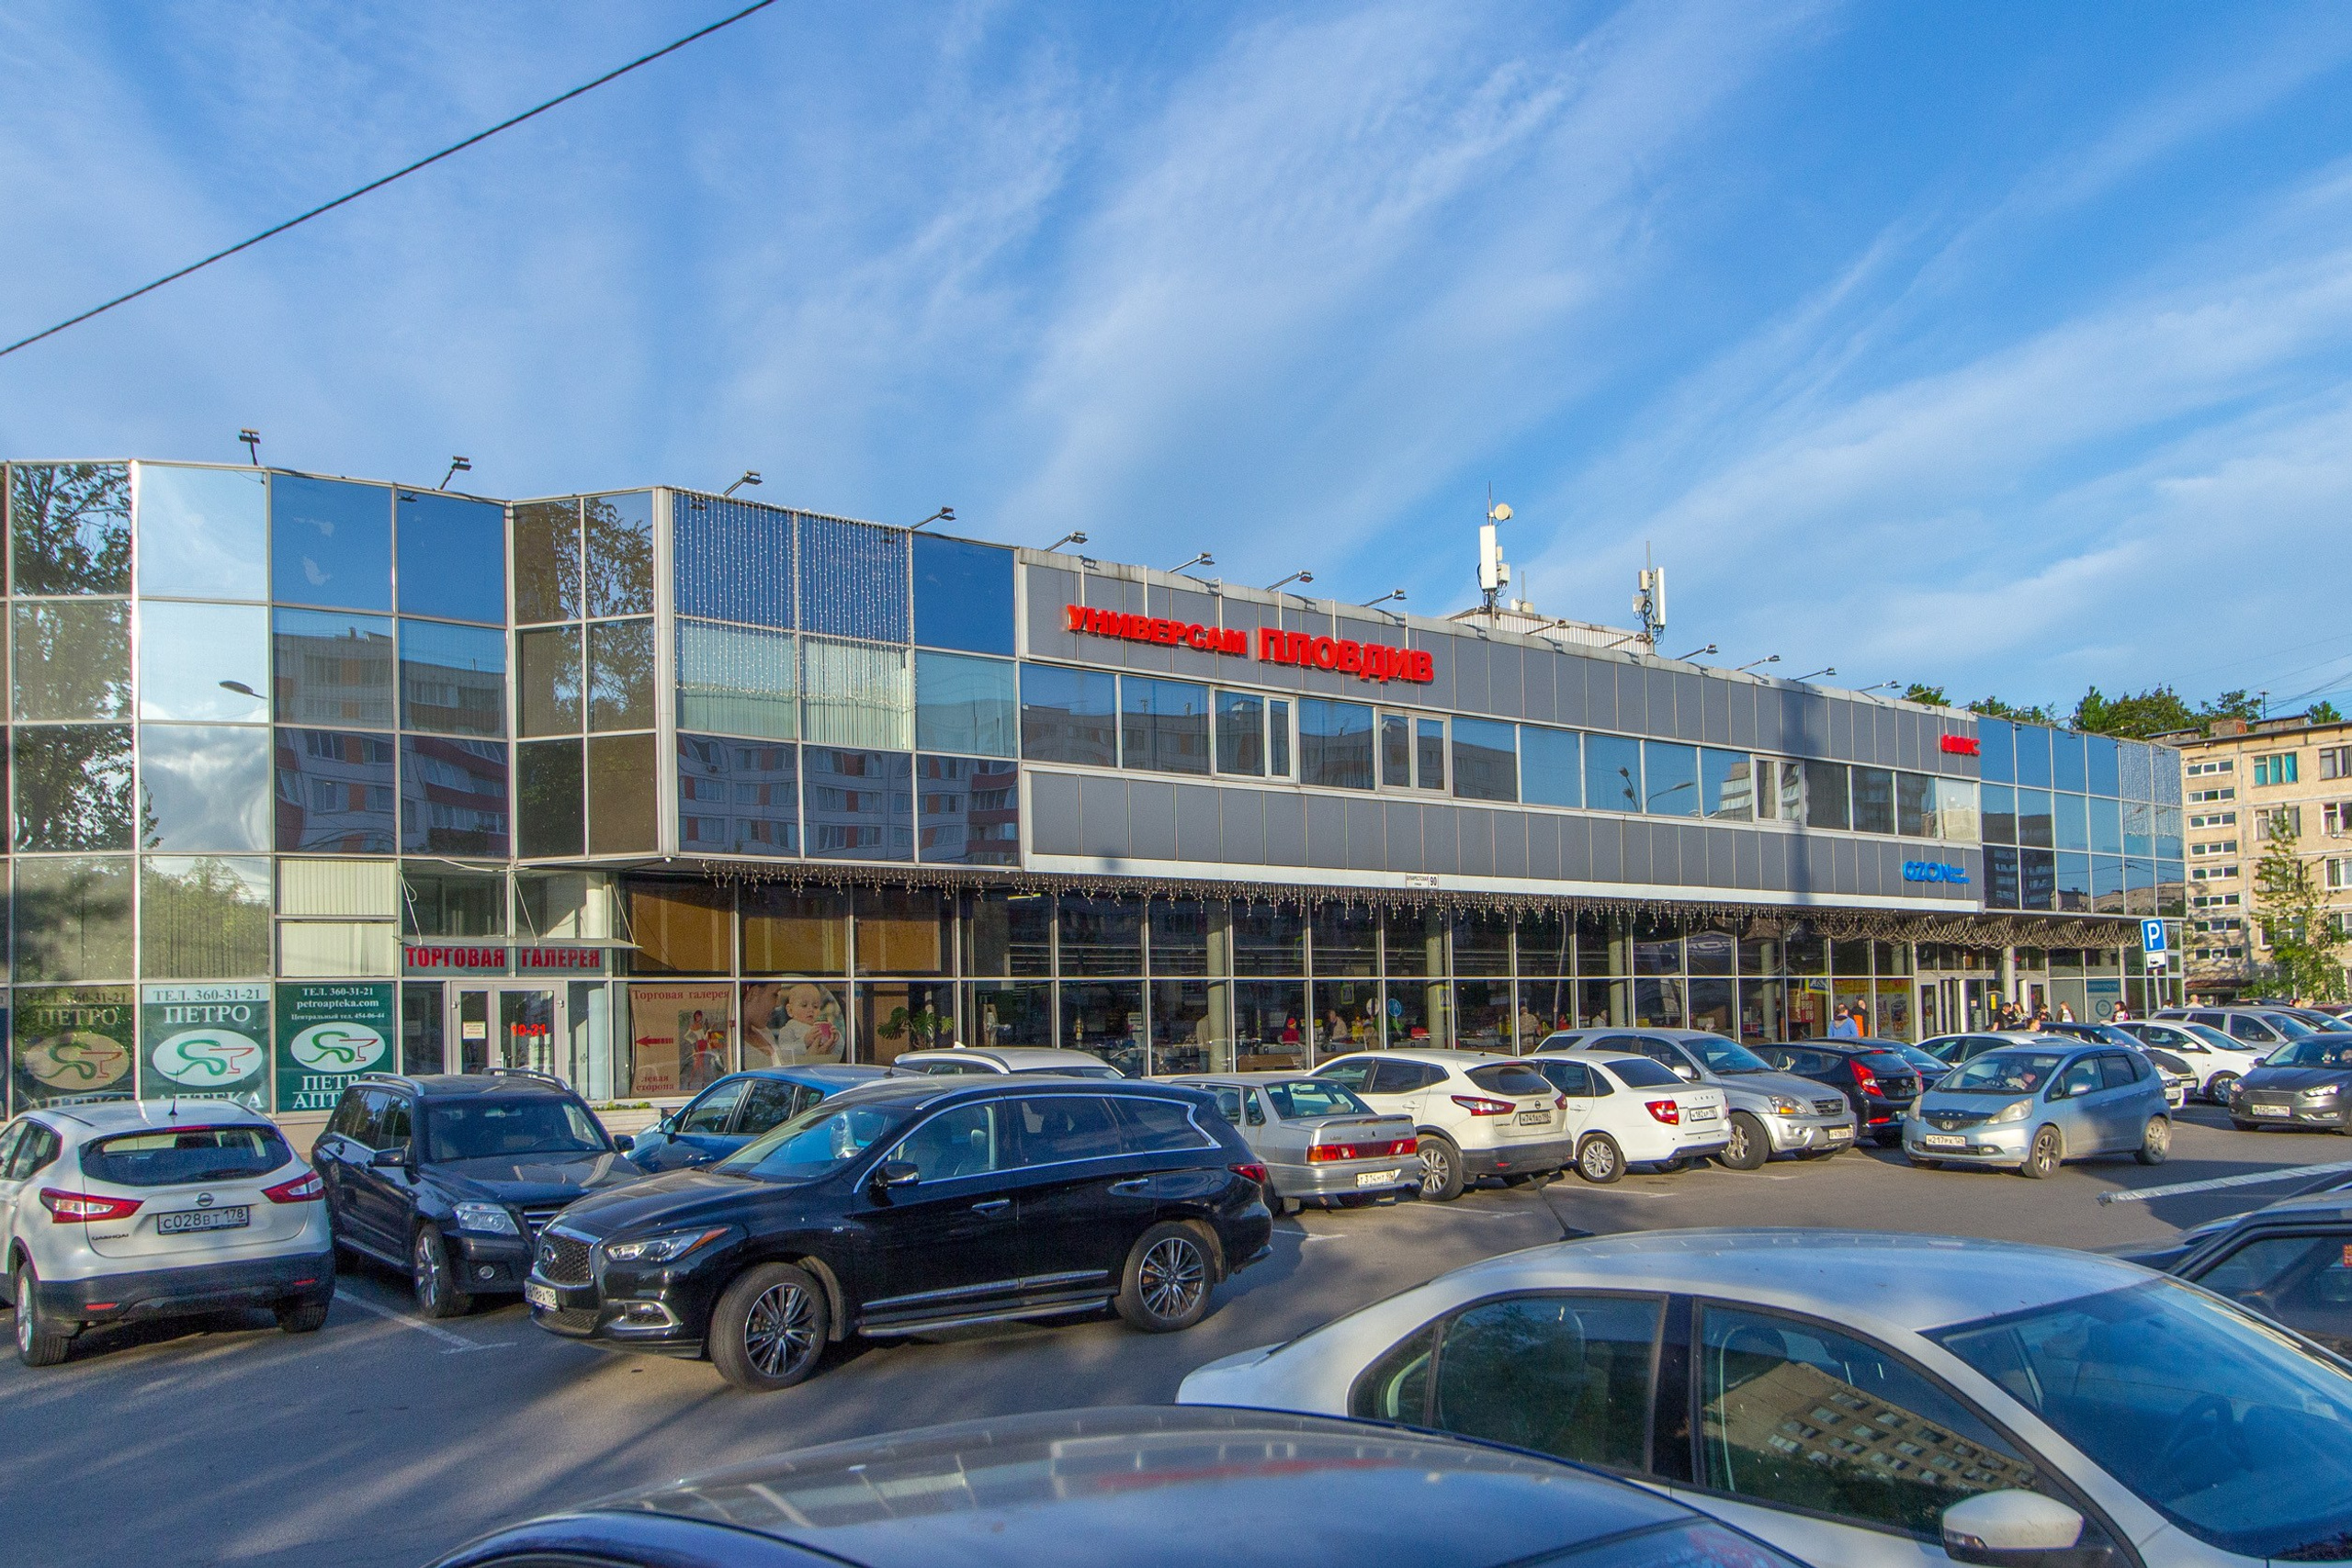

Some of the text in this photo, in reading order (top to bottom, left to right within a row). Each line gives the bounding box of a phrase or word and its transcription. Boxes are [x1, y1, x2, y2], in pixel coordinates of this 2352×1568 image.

[1067, 604, 1434, 682] УНИВЕРСАМ ПЛОВДИВ
[1903, 861, 1951, 882] OZON
[1430, 876, 1437, 886] 90
[406, 948, 600, 967] ТОРГОВАЯ ГАЛЕРЕЯ
[153, 989, 260, 1001] ТЕЛ. 360-31-21
[302, 987, 373, 996] ТЕЛ. 360-31-21
[632, 990, 730, 1001] Торговая галерея
[297, 999, 379, 1010] petroapteka.com
[39, 1009, 118, 1025] ПЕТРО
[164, 1005, 251, 1023] ПЕТРО
[511, 1024, 546, 1036] 10-21
[302, 1075, 359, 1090] ПЕТР
[164, 1208, 243, 1228] С028ВТ 178
